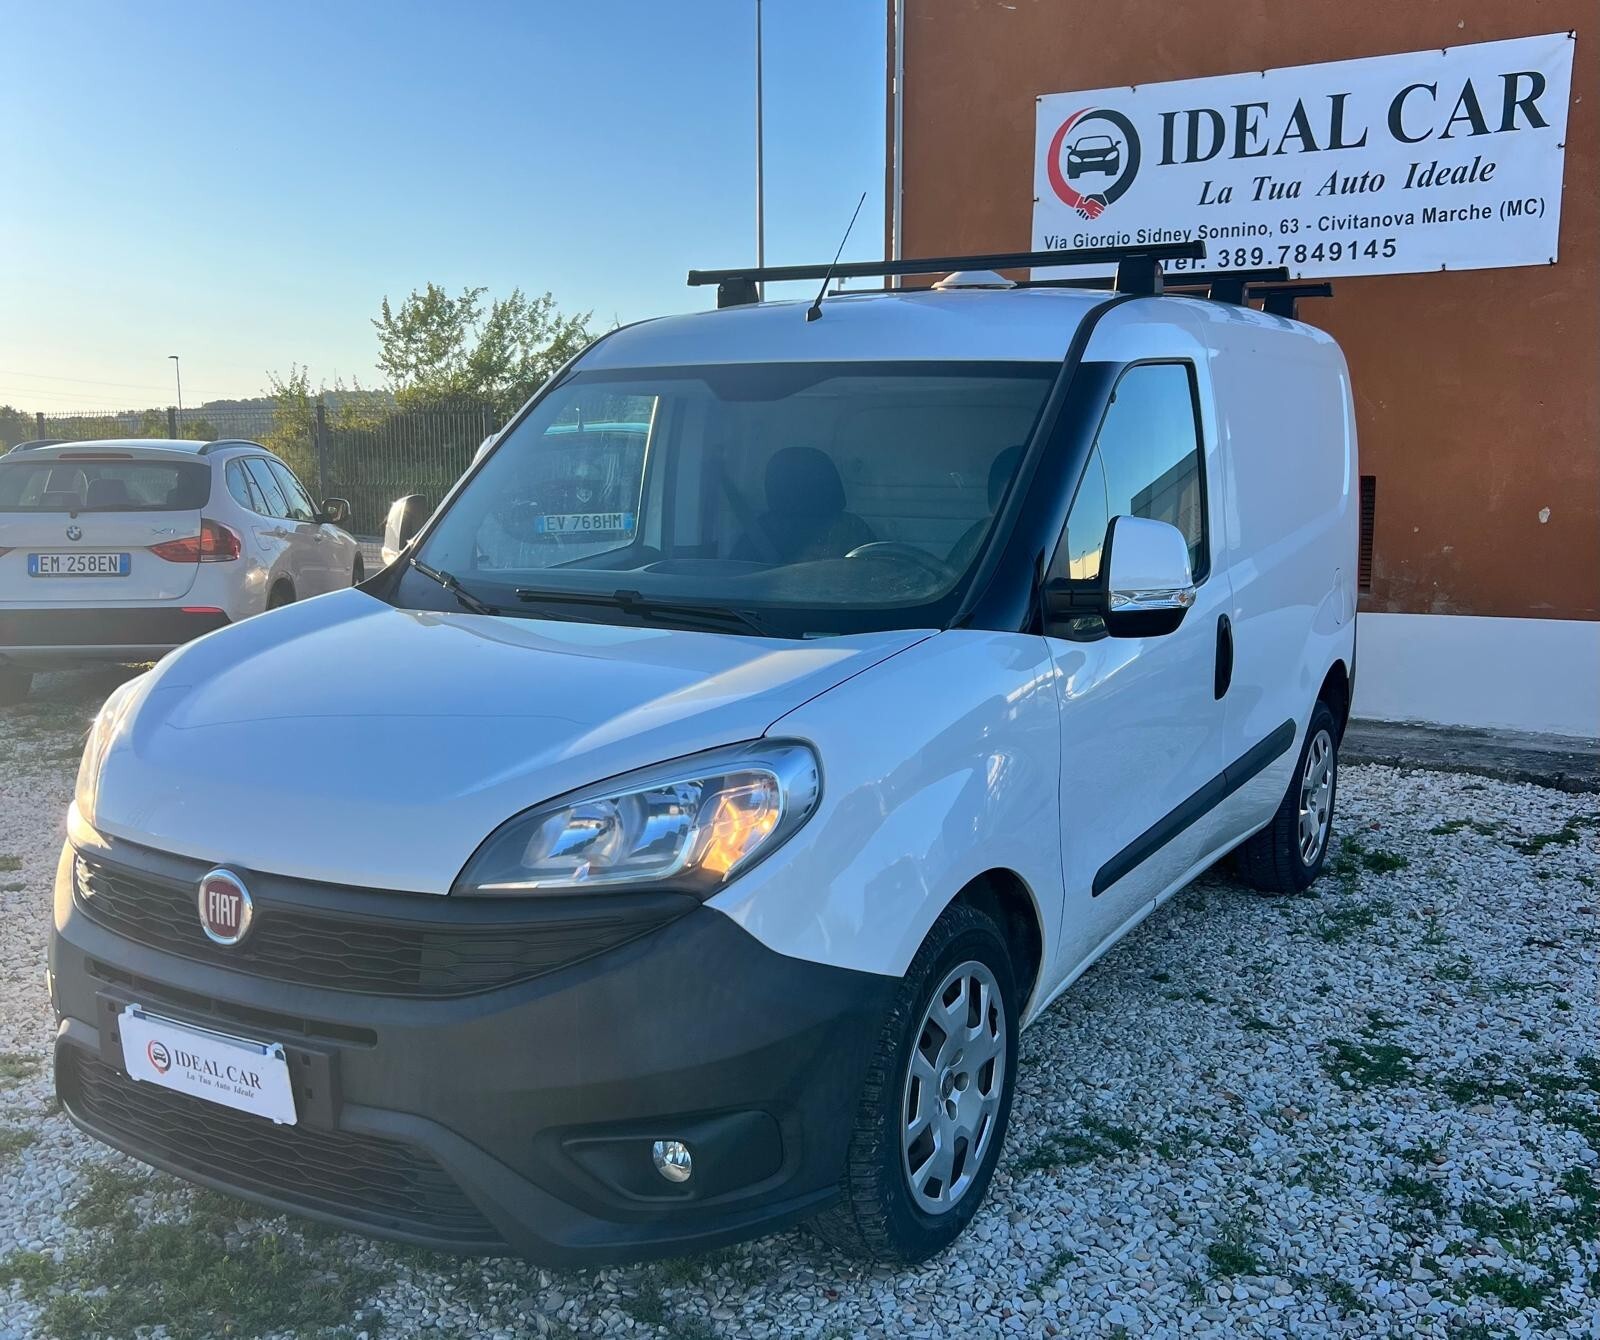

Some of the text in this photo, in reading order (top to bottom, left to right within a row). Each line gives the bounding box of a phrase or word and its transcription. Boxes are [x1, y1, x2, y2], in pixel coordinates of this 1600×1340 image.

[1156, 71, 1550, 166] IDEAL CAR
[1197, 155, 1496, 206] La Tua Auto Ideale
[1044, 235, 1067, 250] Via
[1073, 231, 1131, 248] Giorgio
[1136, 228, 1192, 244] Sidney
[1197, 222, 1273, 240] Sonnino,
[1279, 218, 1299, 234] 63
[1318, 212, 1414, 232] Civitanova
[1422, 204, 1492, 224] Marche
[1499, 197, 1545, 222] (MC)
[1217, 238, 1397, 268] 389.7849145
[546, 514, 622, 531] EV 768HM
[40, 556, 118, 573] EM 258EN
[208, 890, 239, 928] FIAT
[174, 1049, 262, 1090] IDEAL CAR
